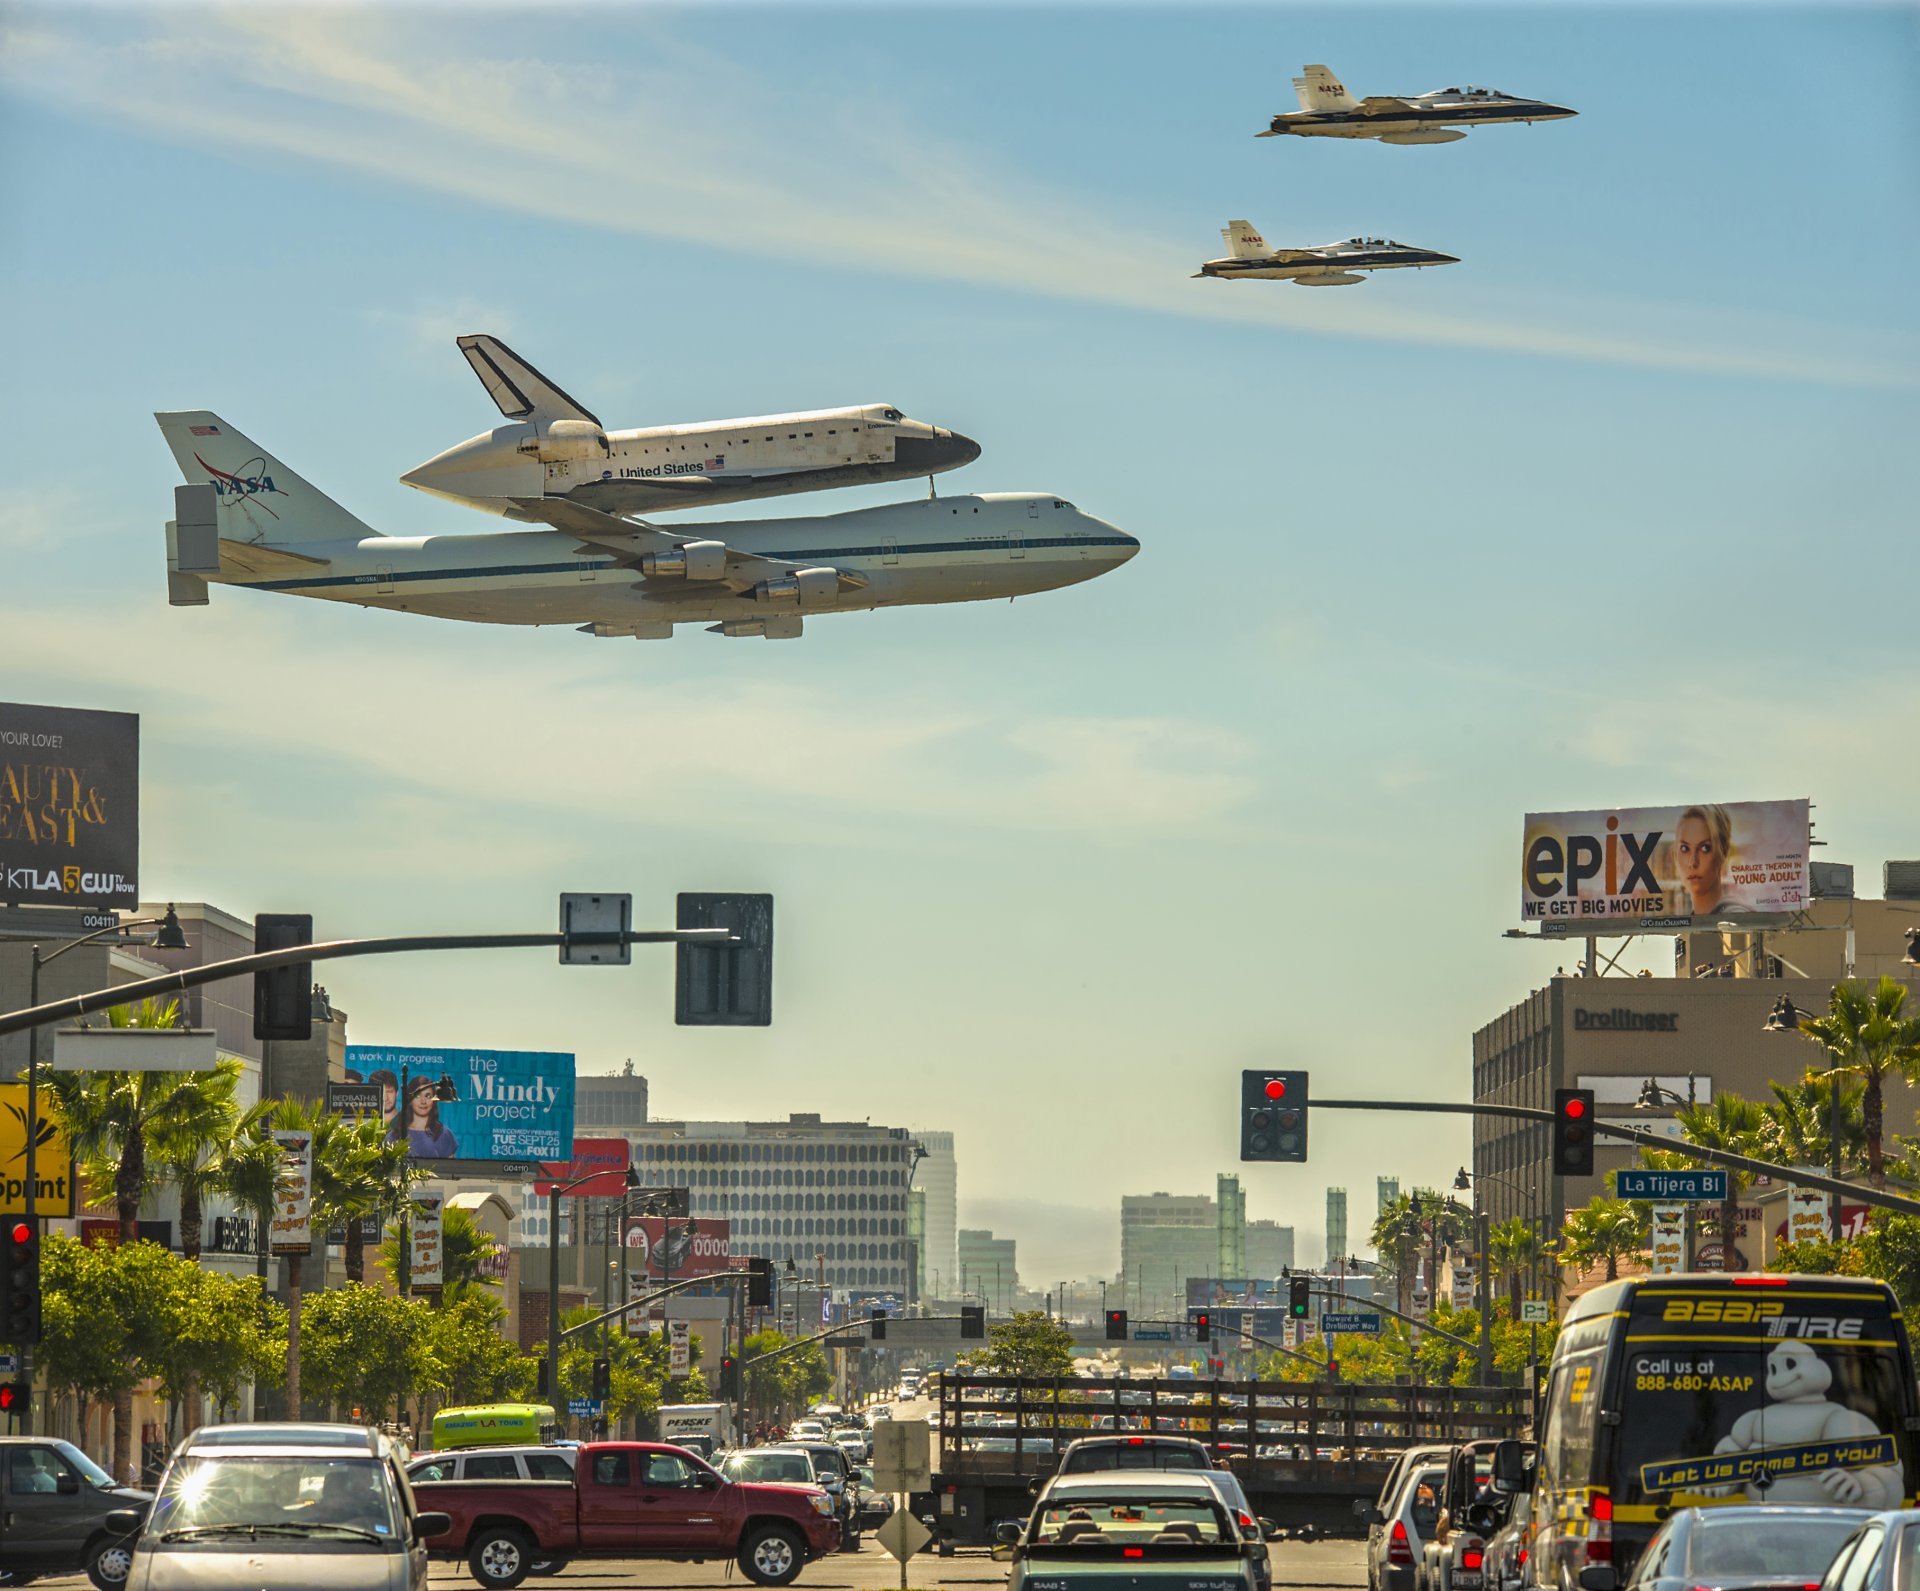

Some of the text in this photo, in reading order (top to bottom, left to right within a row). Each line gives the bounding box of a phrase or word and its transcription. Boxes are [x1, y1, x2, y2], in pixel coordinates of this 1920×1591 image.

[1318, 83, 1344, 93] NASA
[620, 465, 660, 478] United
[664, 462, 704, 475] States
[209, 476, 276, 496] NASA
[0, 731, 63, 748] YOUR LOVE?
[0, 762, 88, 813] AUTY
[0, 803, 80, 848] EAST
[1731, 864, 1763, 873] CHARLIZE
[1765, 862, 1792, 871] THERON
[7, 868, 62, 891] KTLA
[63, 866, 80, 894] 5
[81, 872, 114, 894] CW
[115, 874, 125, 883] TV
[1733, 871, 1802, 885] YOUNG ADULT
[115, 883, 135, 893] NOW
[1525, 897, 1664, 916] WE GET BIG MOVIES
[1574, 1008, 1679, 1031] Drollinger
[359, 1053, 383, 1061] work
[386, 1053, 396, 1061] in
[399, 1055, 445, 1064] progress.
[469, 1055, 497, 1073] the
[468, 1074, 560, 1113] Mindy
[476, 1102, 536, 1121] project
[493, 1135, 560, 1147] TUE SEPT 25
[527, 1146, 549, 1157] FOX
[550, 1147, 560, 1158] 11
[1625, 1177, 1719, 1196] La Tijera Bl
[1792, 1212, 1824, 1226] Shop,
[1325, 1315, 1352, 1323] Howard
[1524, 1304, 1536, 1319] P
[1325, 1322, 1376, 1331] Drollinger Way
[1761, 1316, 1864, 1340] TIRE
[1636, 1359, 1715, 1374] Call us at
[1636, 1375, 1754, 1392] 888-680-ASAP
[480, 1419, 497, 1428] LA
[499, 1419, 524, 1427] TOURS
[666, 1417, 713, 1427] PENSKE
[1657, 1469, 1700, 1486] Let
[1704, 1463, 1734, 1478] Us
[1801, 1451, 1829, 1467] to
[1834, 1444, 1883, 1464] You!
[1033, 1582, 1058, 1590] SAAB
